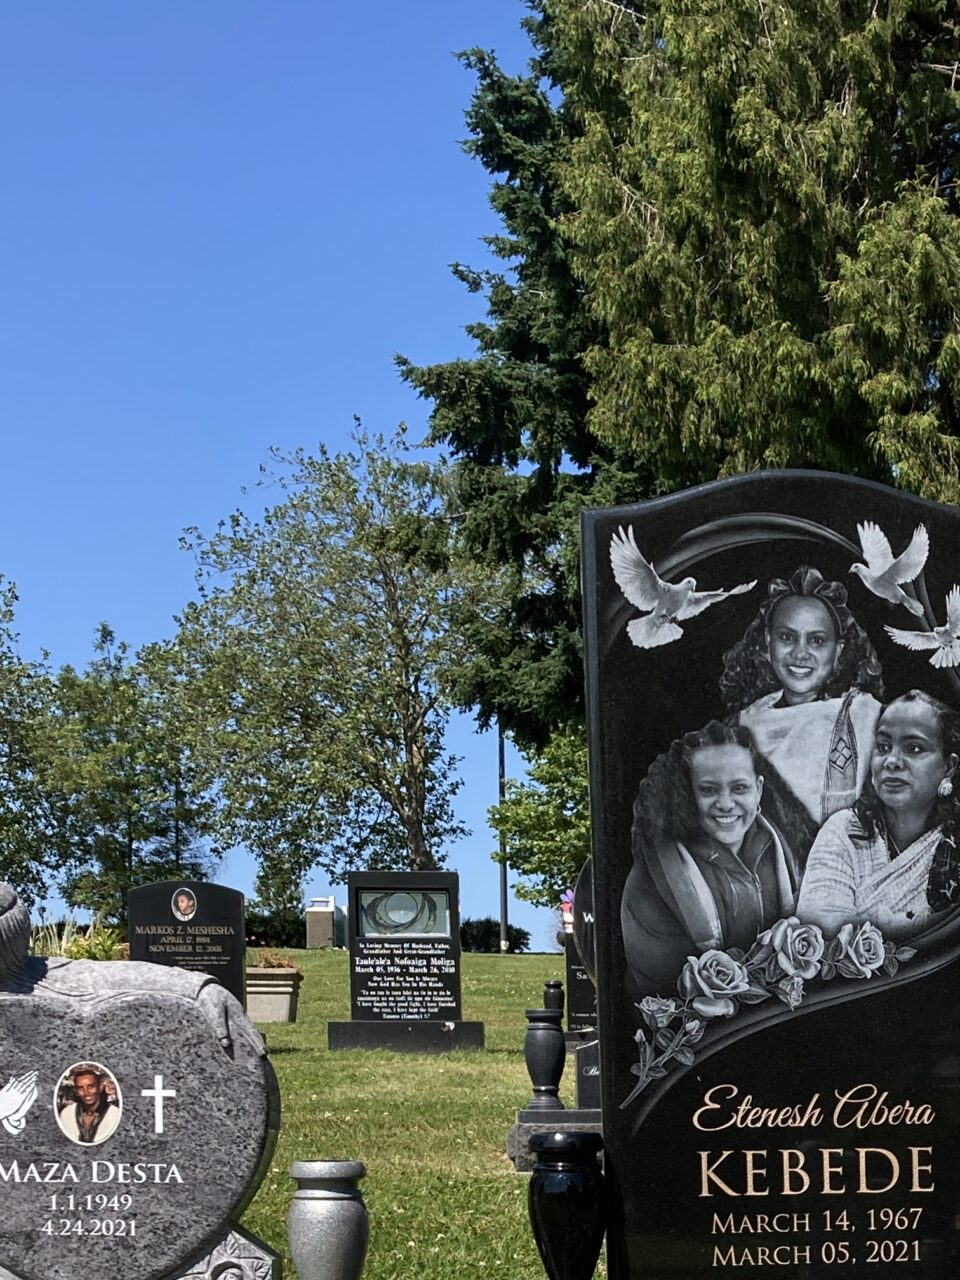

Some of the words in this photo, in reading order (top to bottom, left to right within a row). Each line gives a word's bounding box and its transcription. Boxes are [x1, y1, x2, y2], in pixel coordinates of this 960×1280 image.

[135, 926, 174, 935] MARKOS
[187, 926, 235, 936] MESHESHA
[149, 944, 193, 953] NOVEMBER
[692, 1084, 824, 1132] Etenesh
[833, 1083, 936, 1129] Abera
[0, 1159, 81, 1184] MAZA
[90, 1160, 186, 1184] DESTA
[696, 1146, 936, 1197] KEBEDE
[49, 1194, 133, 1211] 1.1.1949
[41, 1219, 138, 1237] 4.24.2021
[711, 1211, 811, 1235] MARCH
[821, 1209, 857, 1233] 14,
[866, 1207, 924, 1232] 1967
[711, 1244, 812, 1267] MARCH
[820, 1242, 857, 1265] 05,
[864, 1240, 922, 1263] 2021
